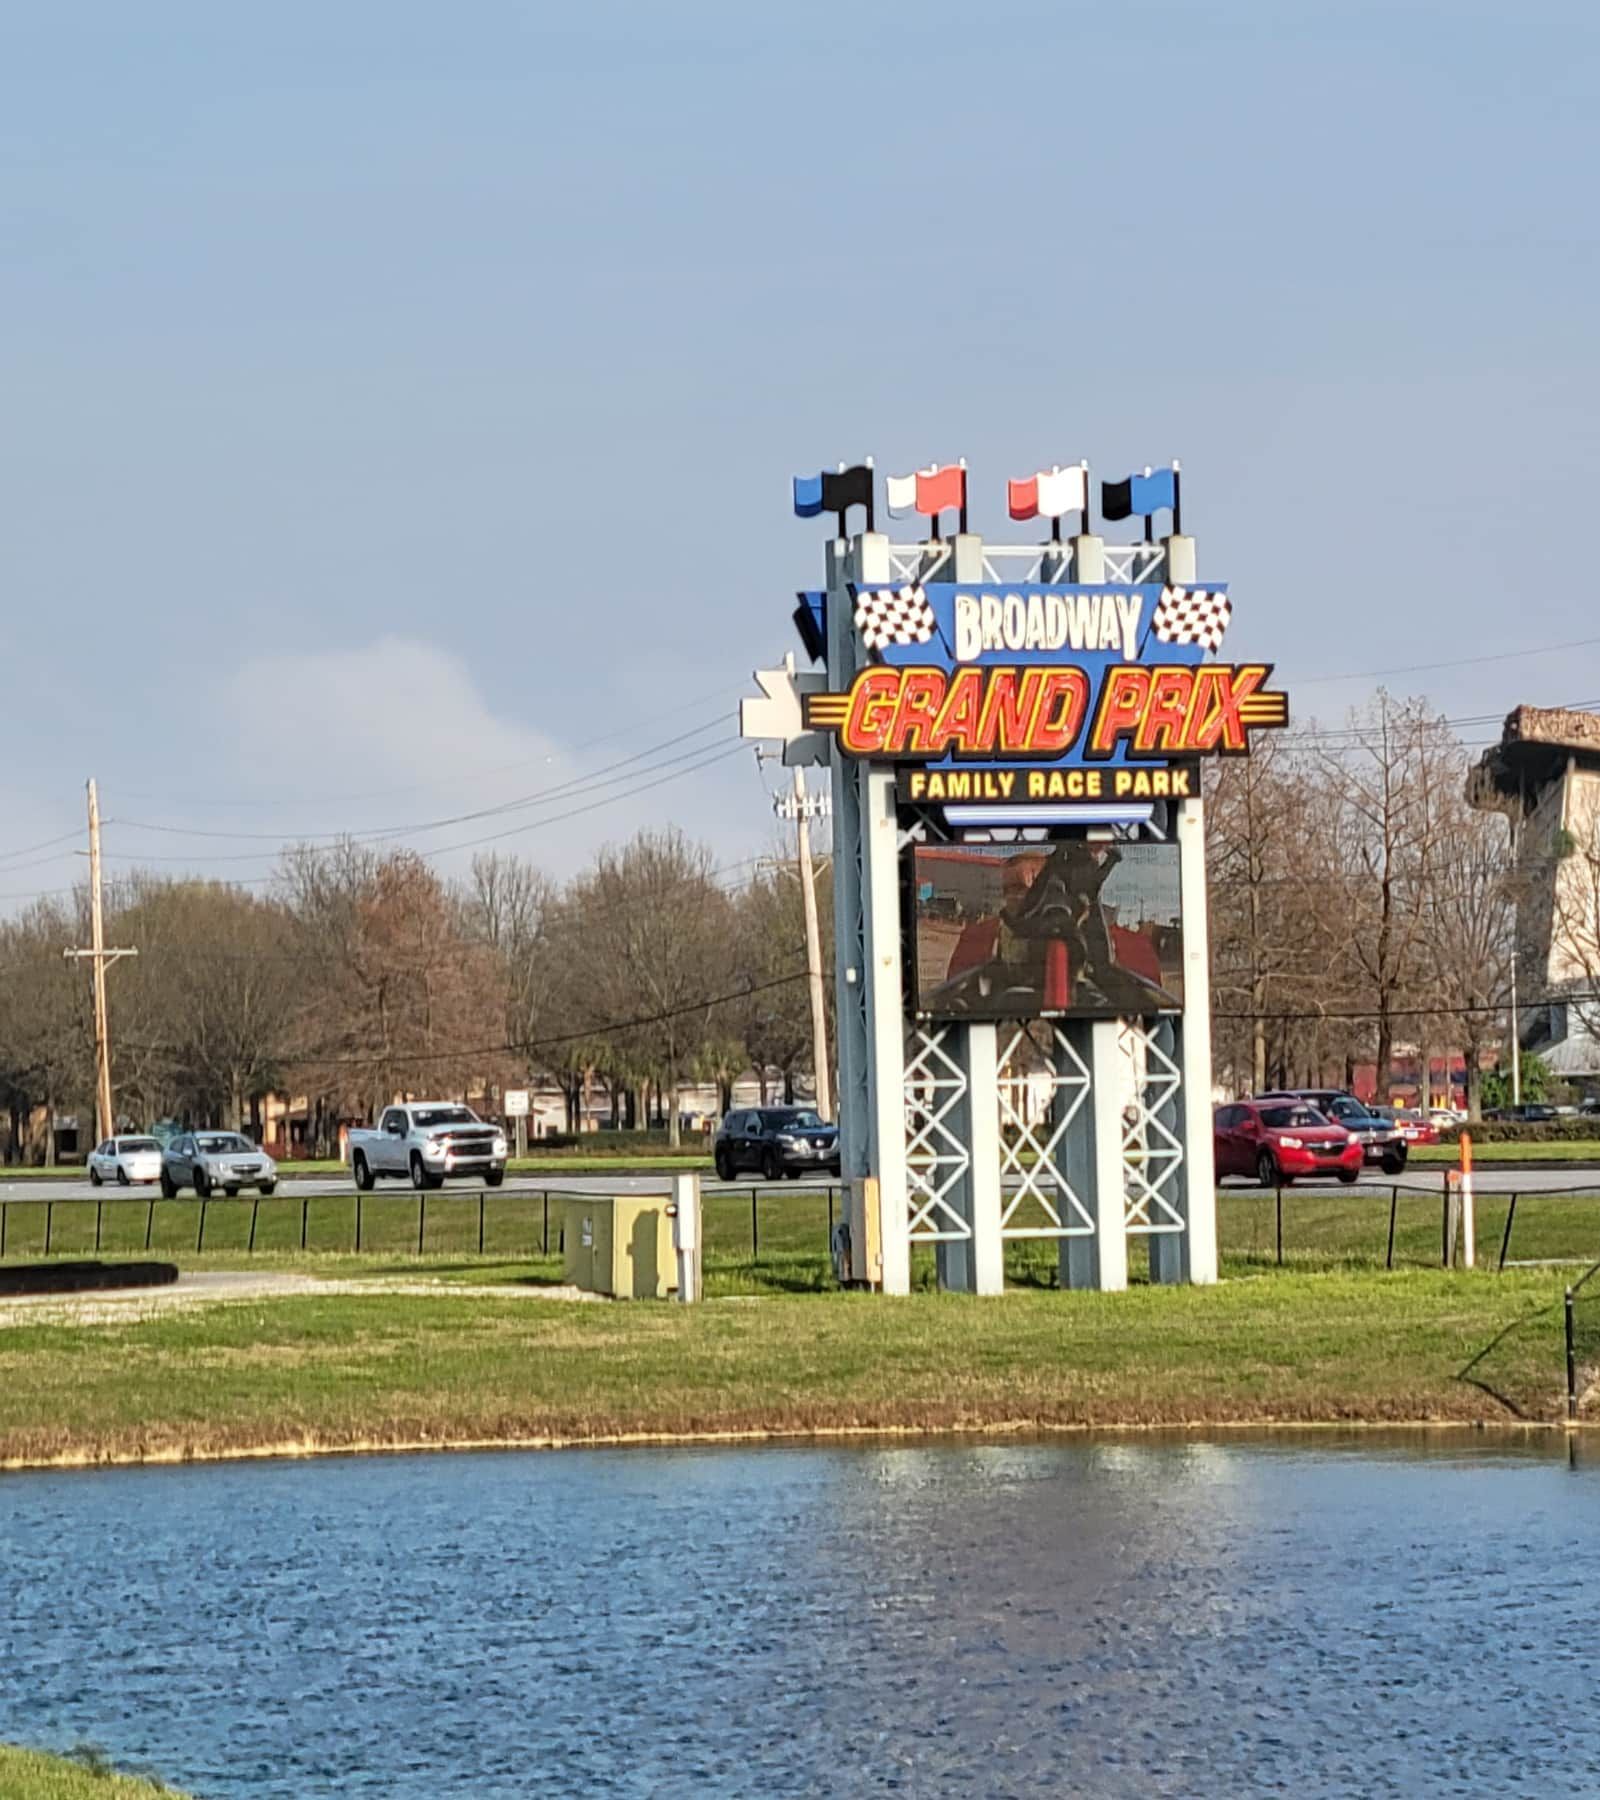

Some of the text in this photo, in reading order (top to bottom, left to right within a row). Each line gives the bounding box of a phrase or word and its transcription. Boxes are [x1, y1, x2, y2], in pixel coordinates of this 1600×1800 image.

[954, 593, 1144, 662] BROADWAY
[842, 666, 1266, 752] GRAND PRIX
[910, 769, 1191, 799] FAMILY RACE PARK
